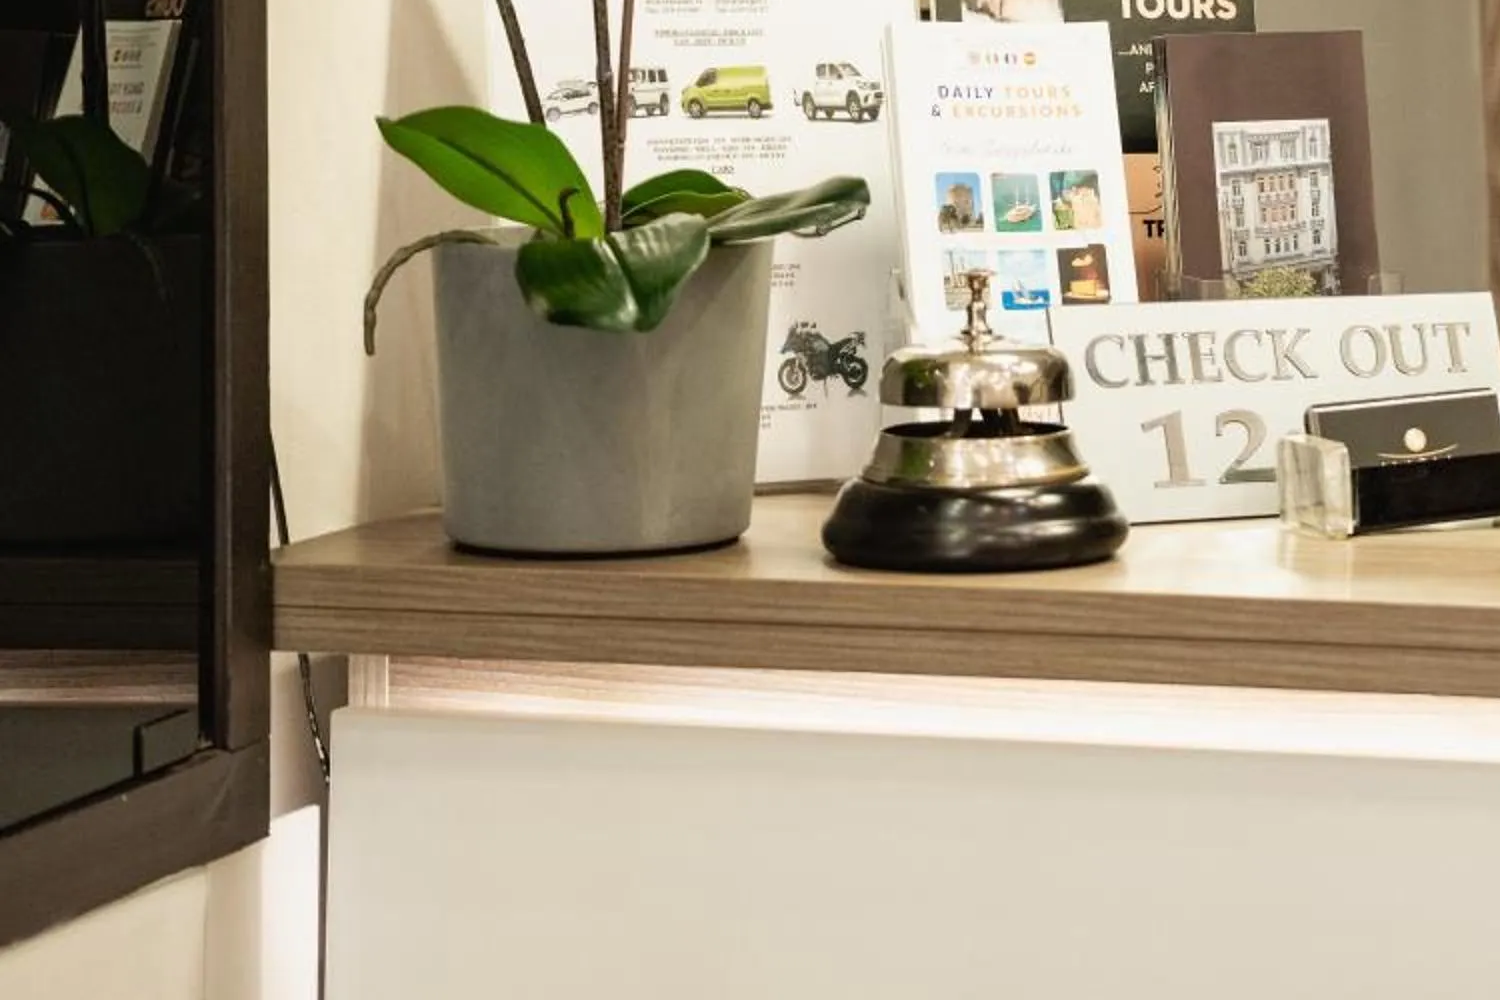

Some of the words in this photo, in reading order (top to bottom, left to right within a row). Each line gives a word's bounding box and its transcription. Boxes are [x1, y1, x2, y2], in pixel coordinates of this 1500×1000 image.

[931, 104, 941, 117] &
[952, 104, 1083, 118] EXCURSIONS
[937, 85, 993, 99] DAILY
[1004, 86, 1071, 99] TOURS
[1084, 328, 1320, 388] CHECK
[1339, 321, 1471, 379] OUT
[1141, 409, 1278, 488] 12
